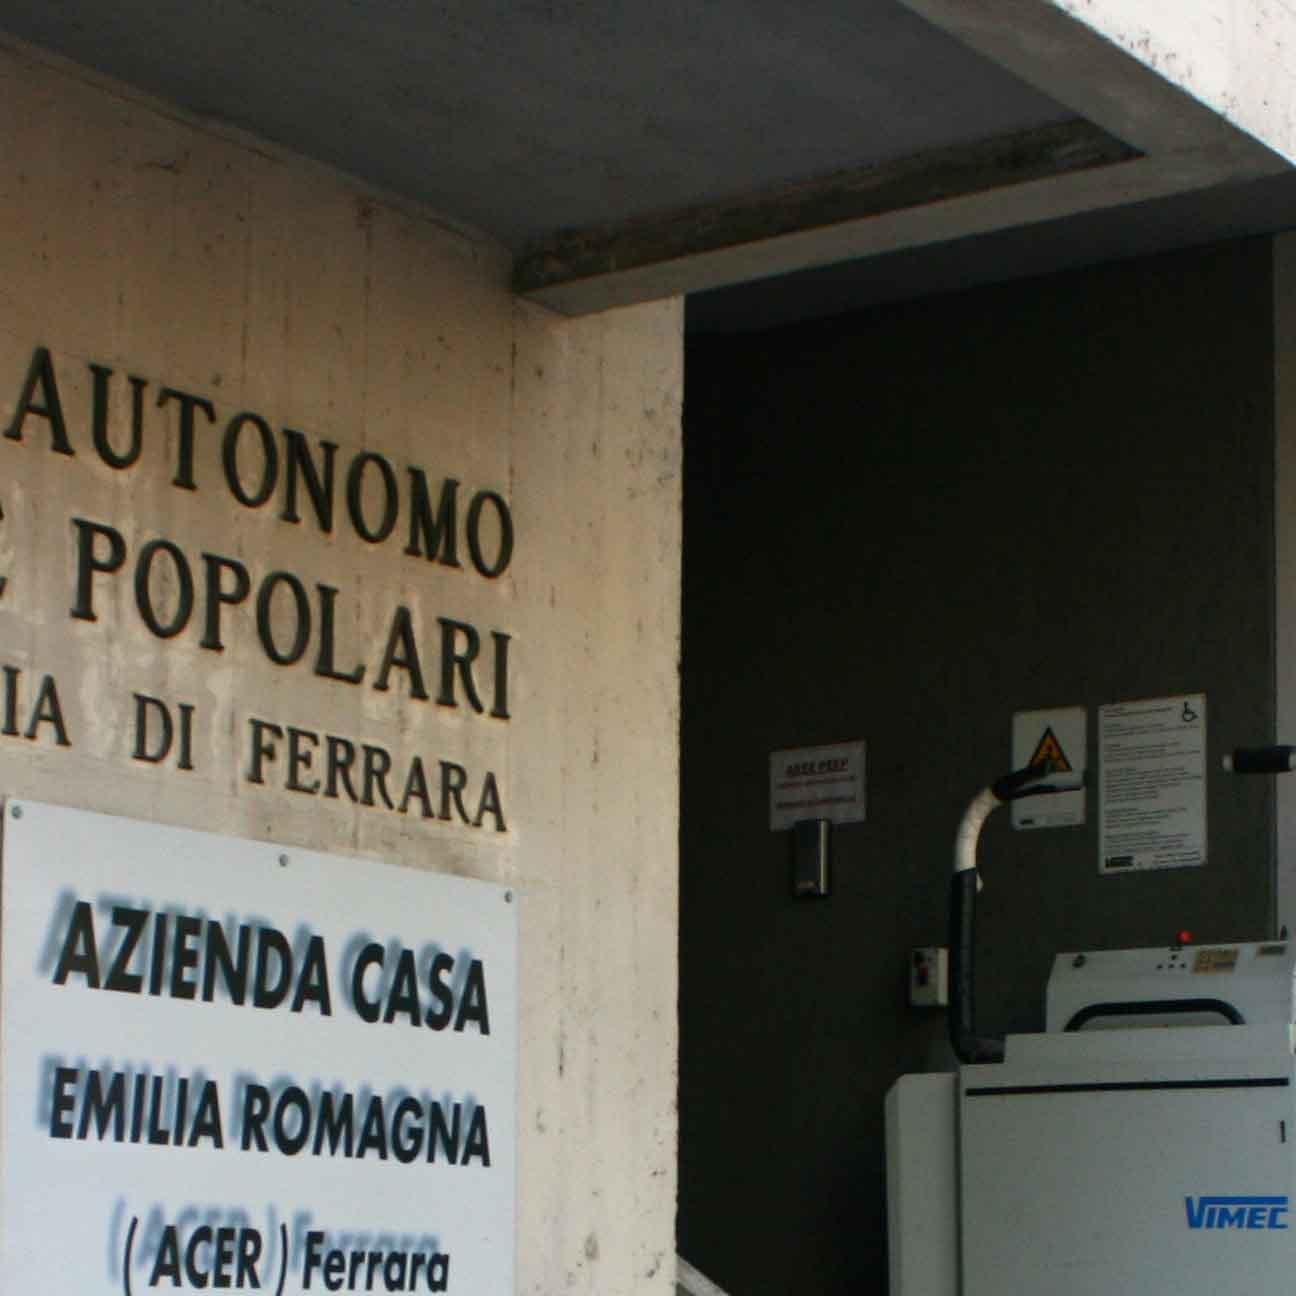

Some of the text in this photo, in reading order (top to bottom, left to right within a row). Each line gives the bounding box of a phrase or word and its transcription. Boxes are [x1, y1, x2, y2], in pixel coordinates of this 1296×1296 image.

[3, 346, 514, 580] AUTONOMO
[70, 516, 512, 720] POPOLARI
[131, 692, 195, 771] DI
[247, 717, 508, 832] FERRARA
[52, 901, 490, 1036] AZIENDA CASA
[48, 1066, 491, 1168] EMILIA ROMAGNA
[302, 1231, 450, 1293] Ferrara
